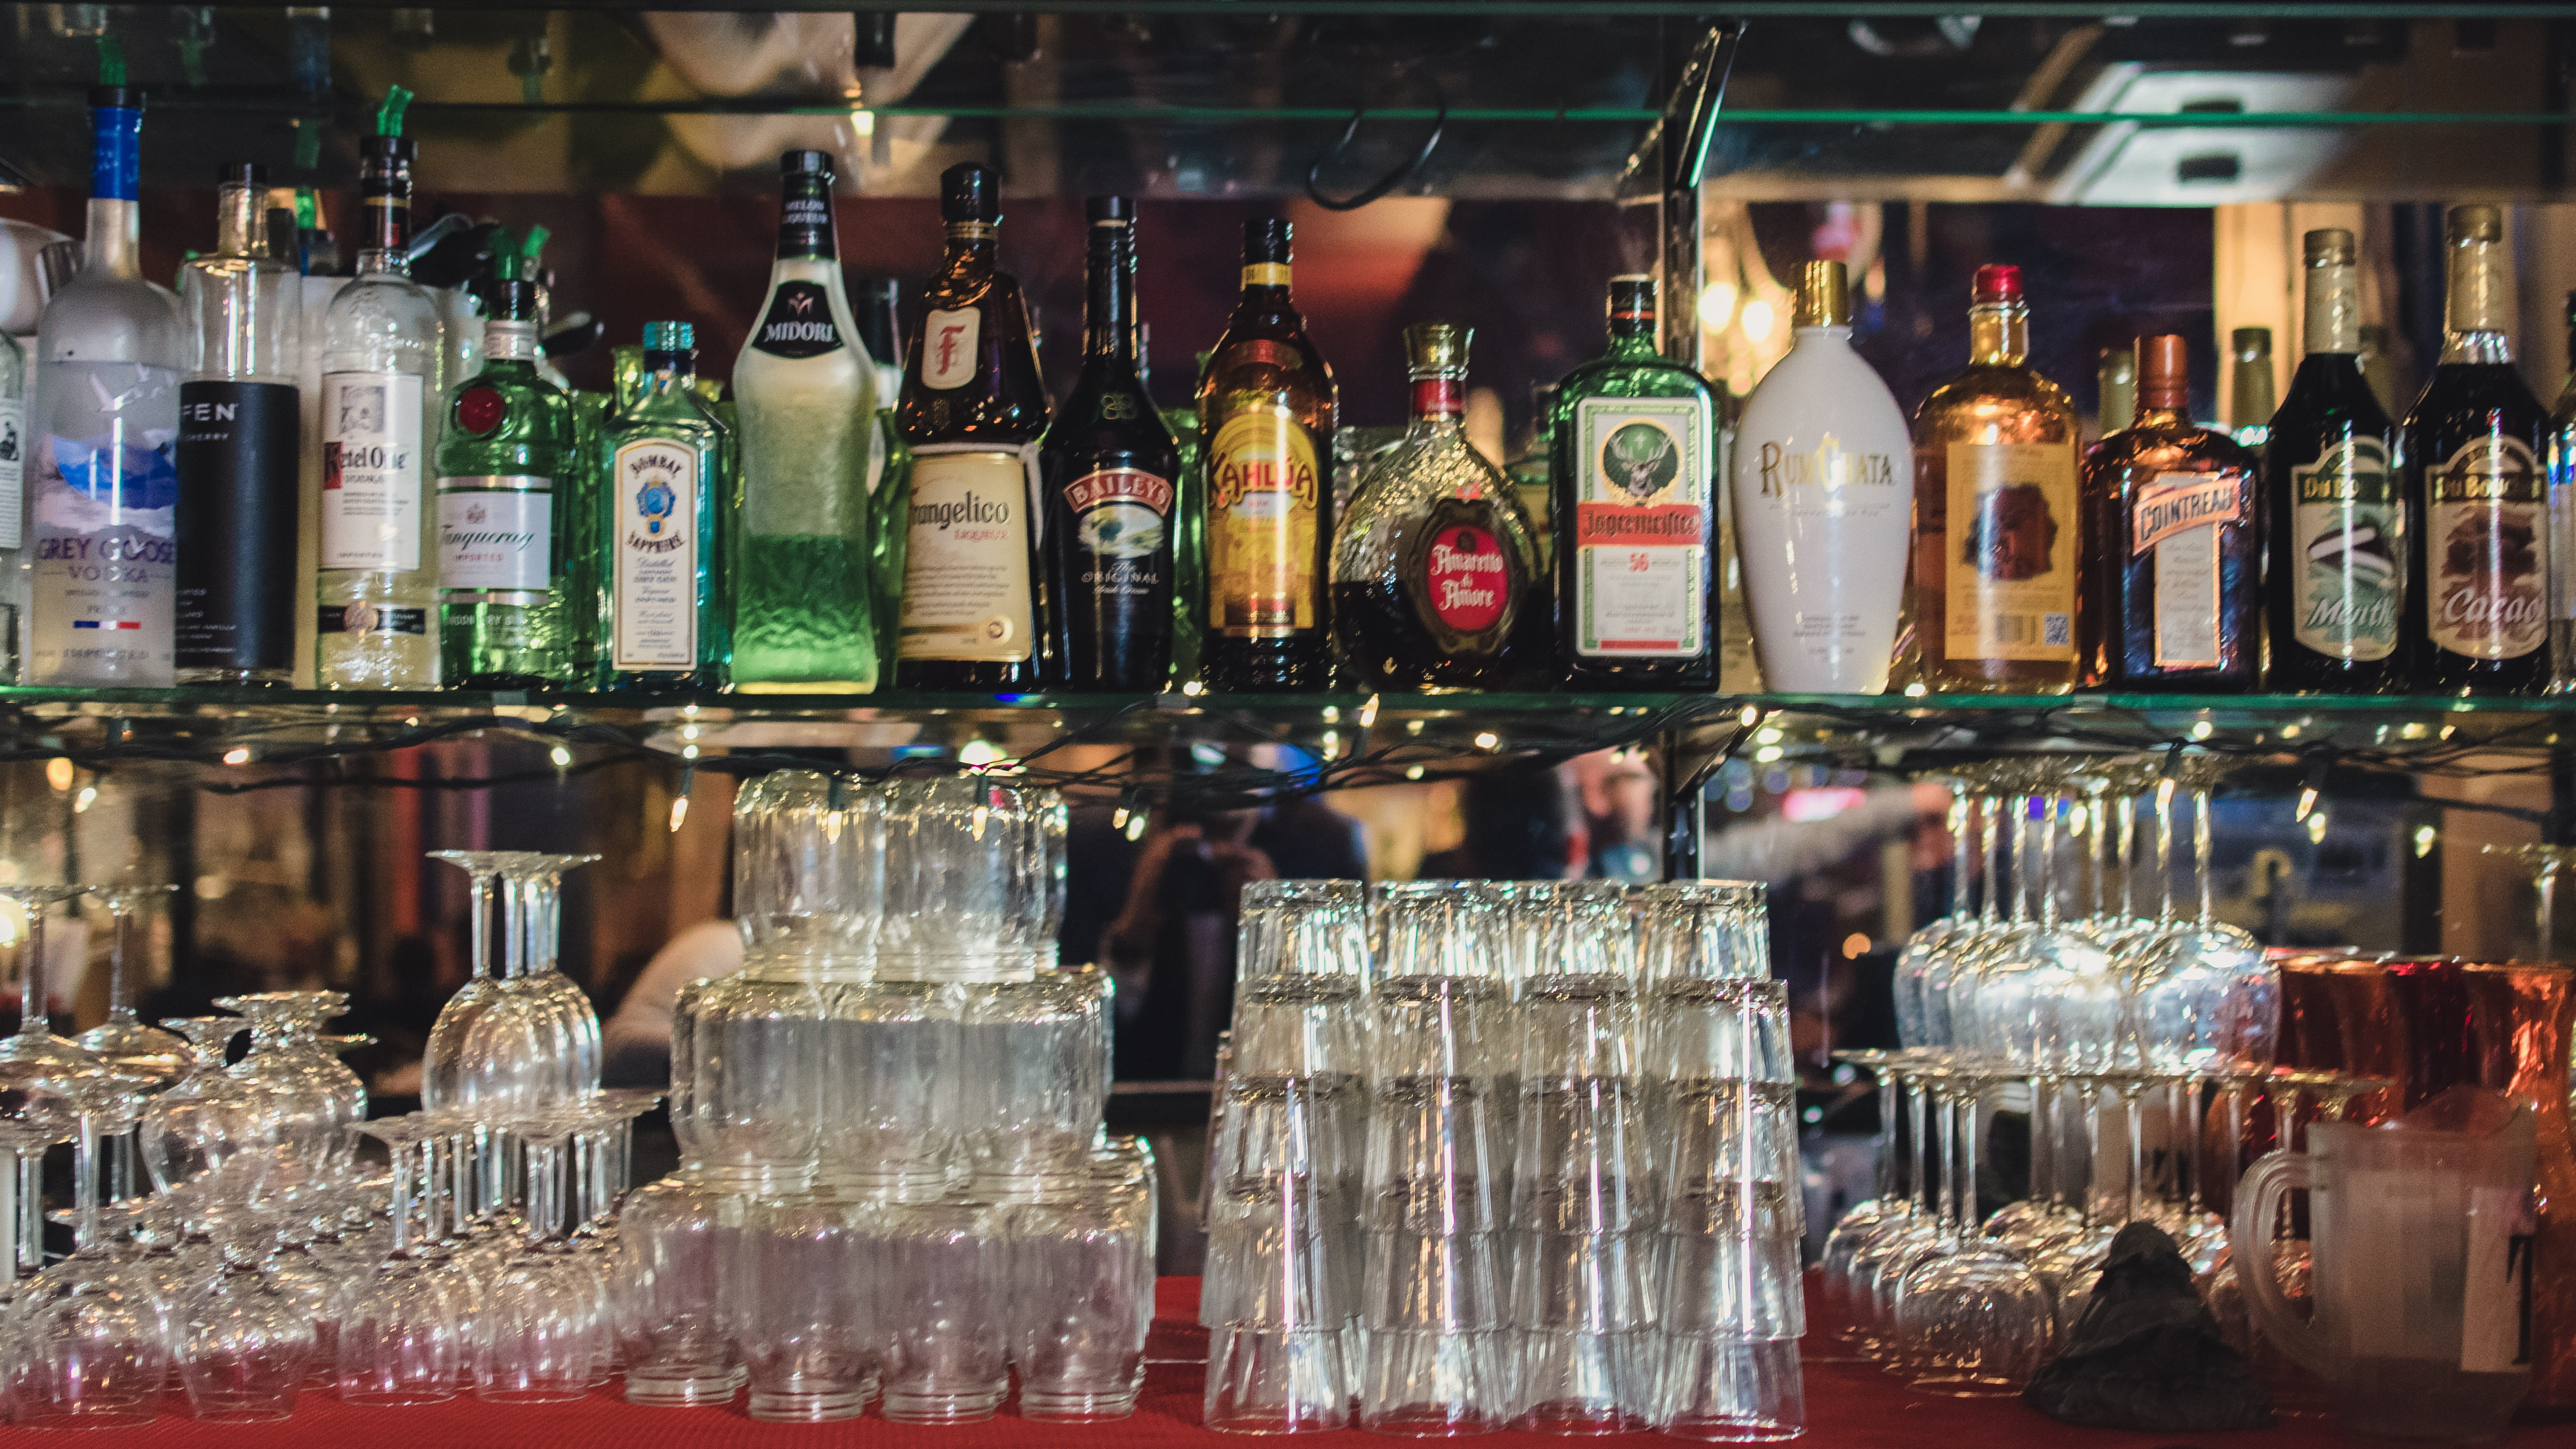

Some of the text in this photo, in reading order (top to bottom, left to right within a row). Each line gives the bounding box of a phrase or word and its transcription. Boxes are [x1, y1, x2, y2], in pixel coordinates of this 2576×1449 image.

[764, 322, 834, 343] MIDORI
[630, 455, 683, 479] BOMBAY
[1072, 474, 1166, 505] BAILEYS
[2140, 488, 2233, 542] COINTREAU
[39, 538, 92, 559] GREY
[441, 524, 535, 552] Tanqueray
[627, 529, 686, 554] SAPPHIRE
[1430, 544, 1503, 576] Amaretto
[1628, 552, 1649, 572] 56
[1081, 571, 1159, 584] ORIGINAL
[1439, 579, 1495, 611] Amore
[2445, 586, 2539, 624] Cacao
